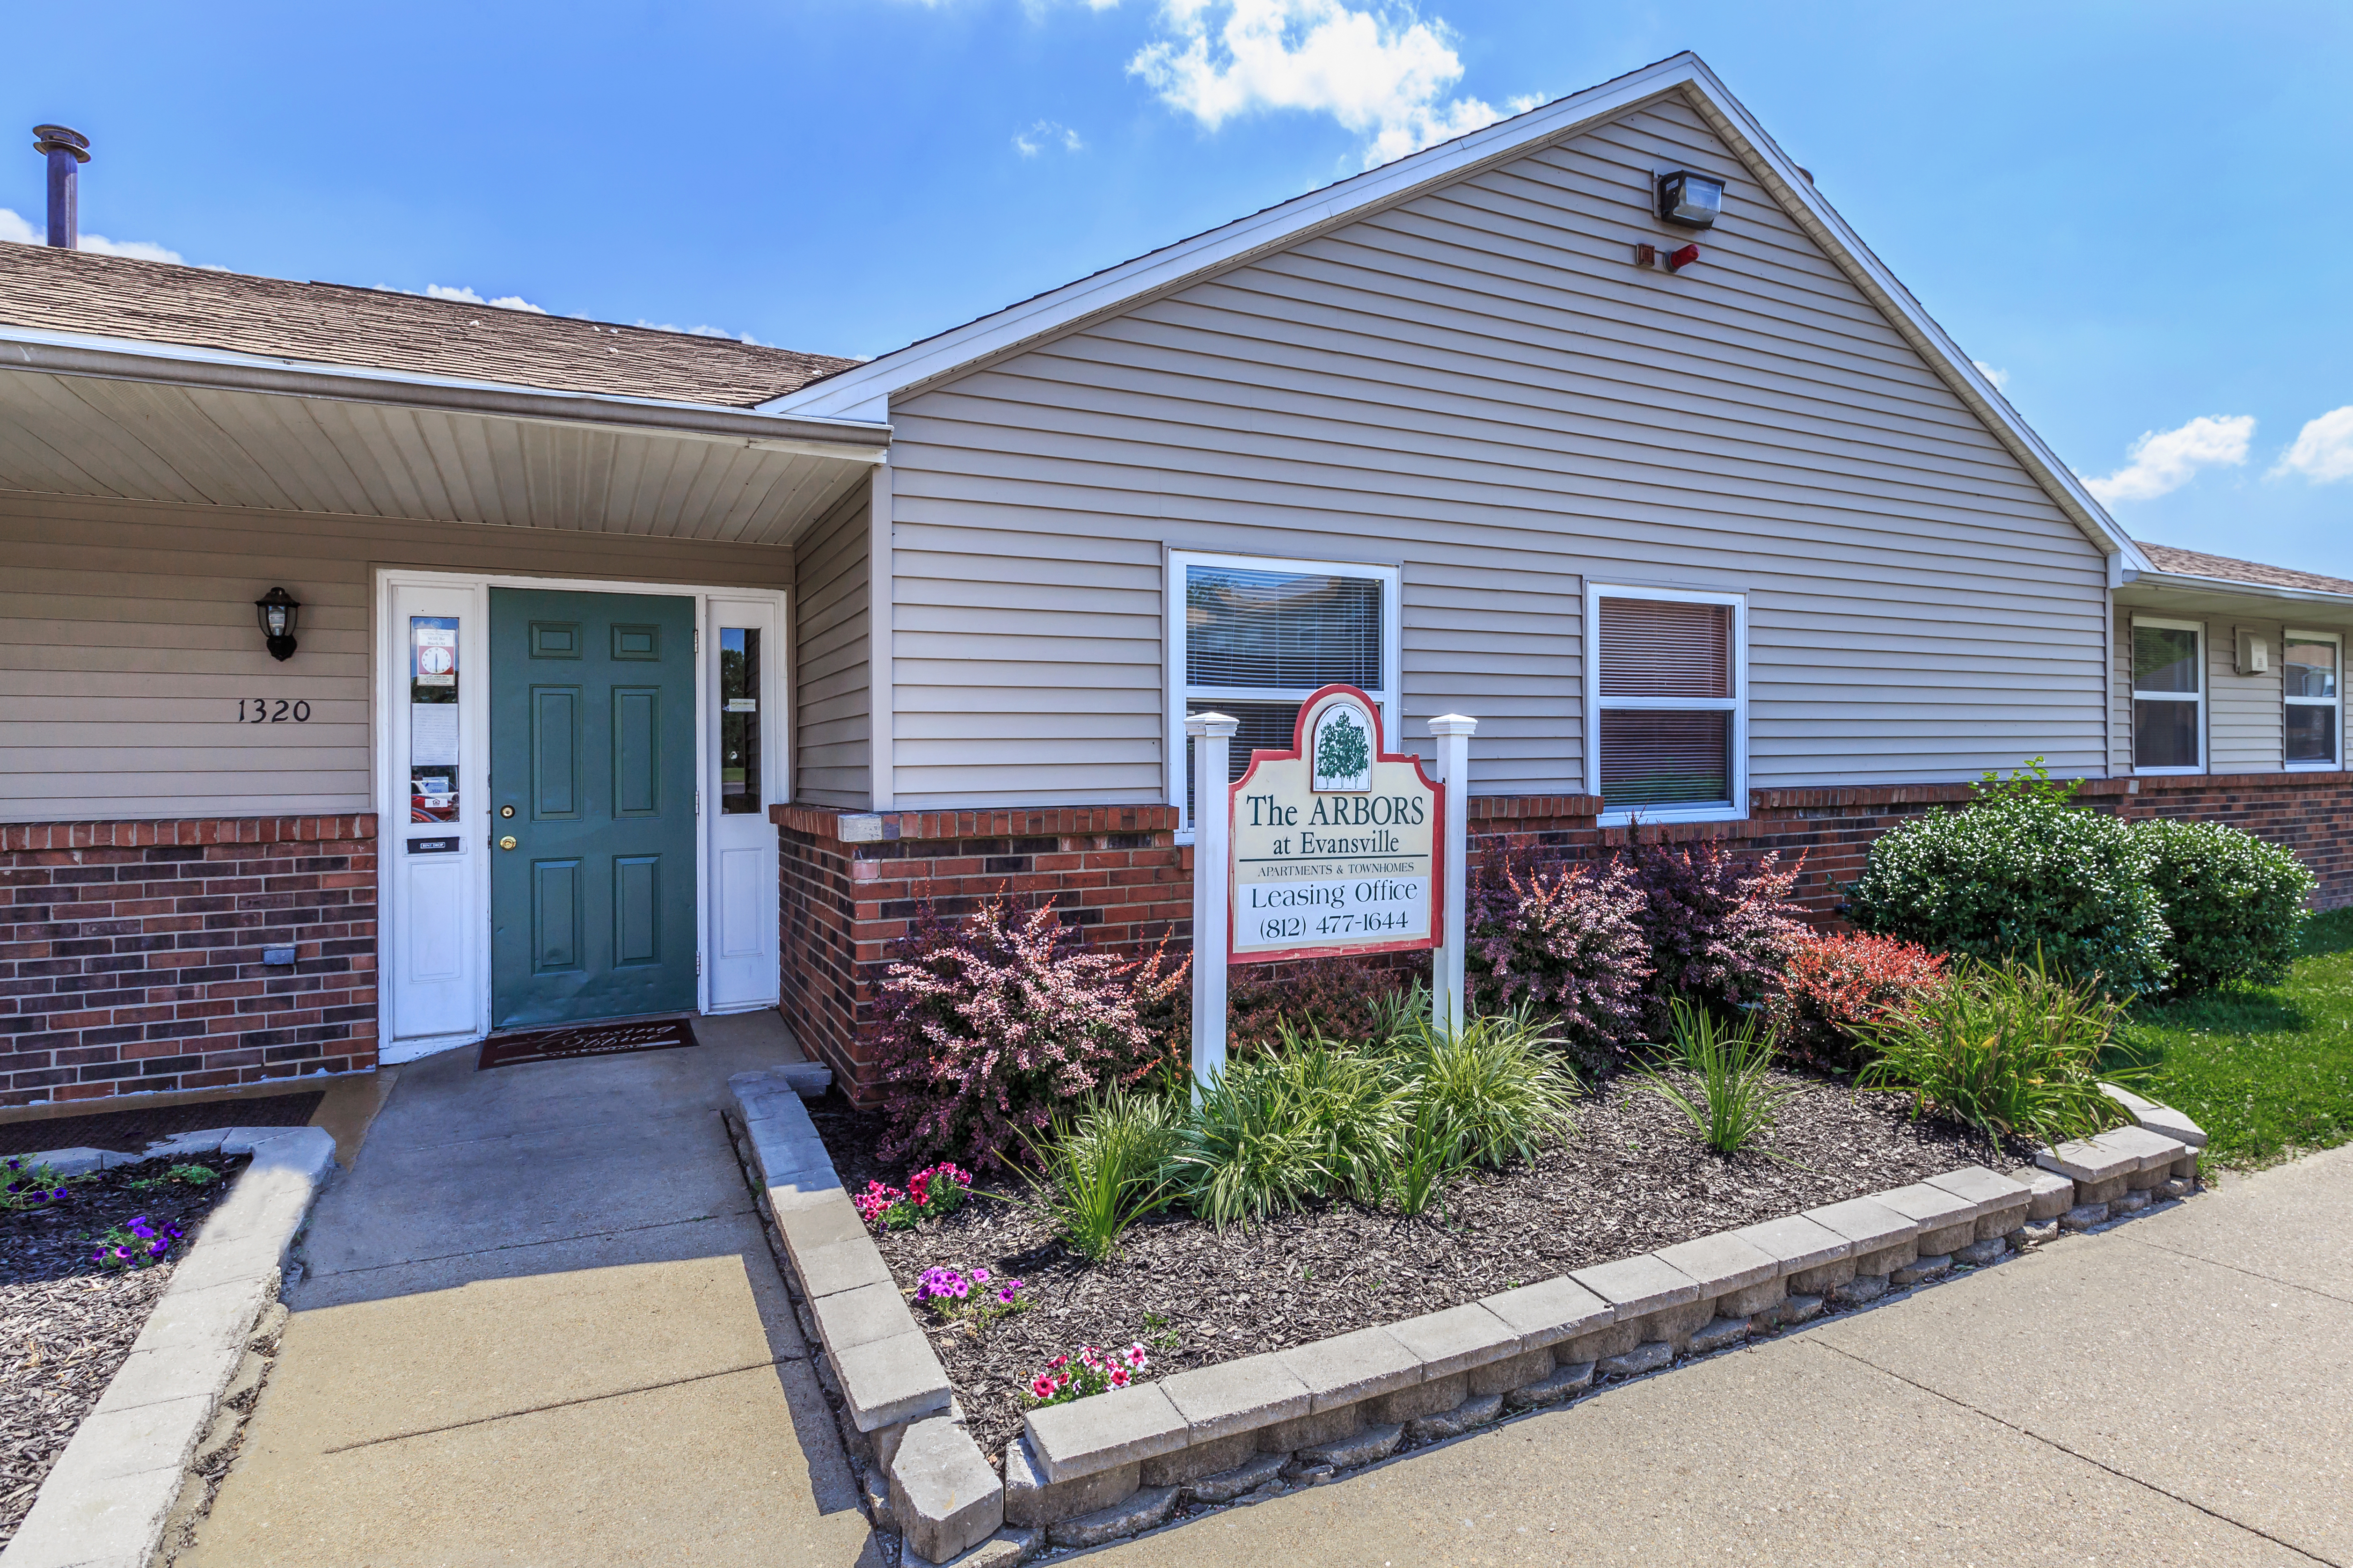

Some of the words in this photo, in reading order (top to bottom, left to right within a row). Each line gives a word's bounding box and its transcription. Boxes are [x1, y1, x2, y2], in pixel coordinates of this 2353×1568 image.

[239, 699, 310, 723] 1320
[1246, 794, 1298, 826] The
[1308, 795, 1424, 826] ARBORS
[1273, 836, 1291, 855] at
[1300, 829, 1399, 854] Evansville
[1257, 865, 1333, 877] APARTMENTS
[1336, 865, 1344, 875] &
[1348, 862, 1414, 874] TOWNHOMES
[1252, 884, 1345, 909] Leasing
[1355, 879, 1418, 903] Office
[1260, 916, 1307, 941] (812)
[1315, 910, 1409, 934] 477-1644
